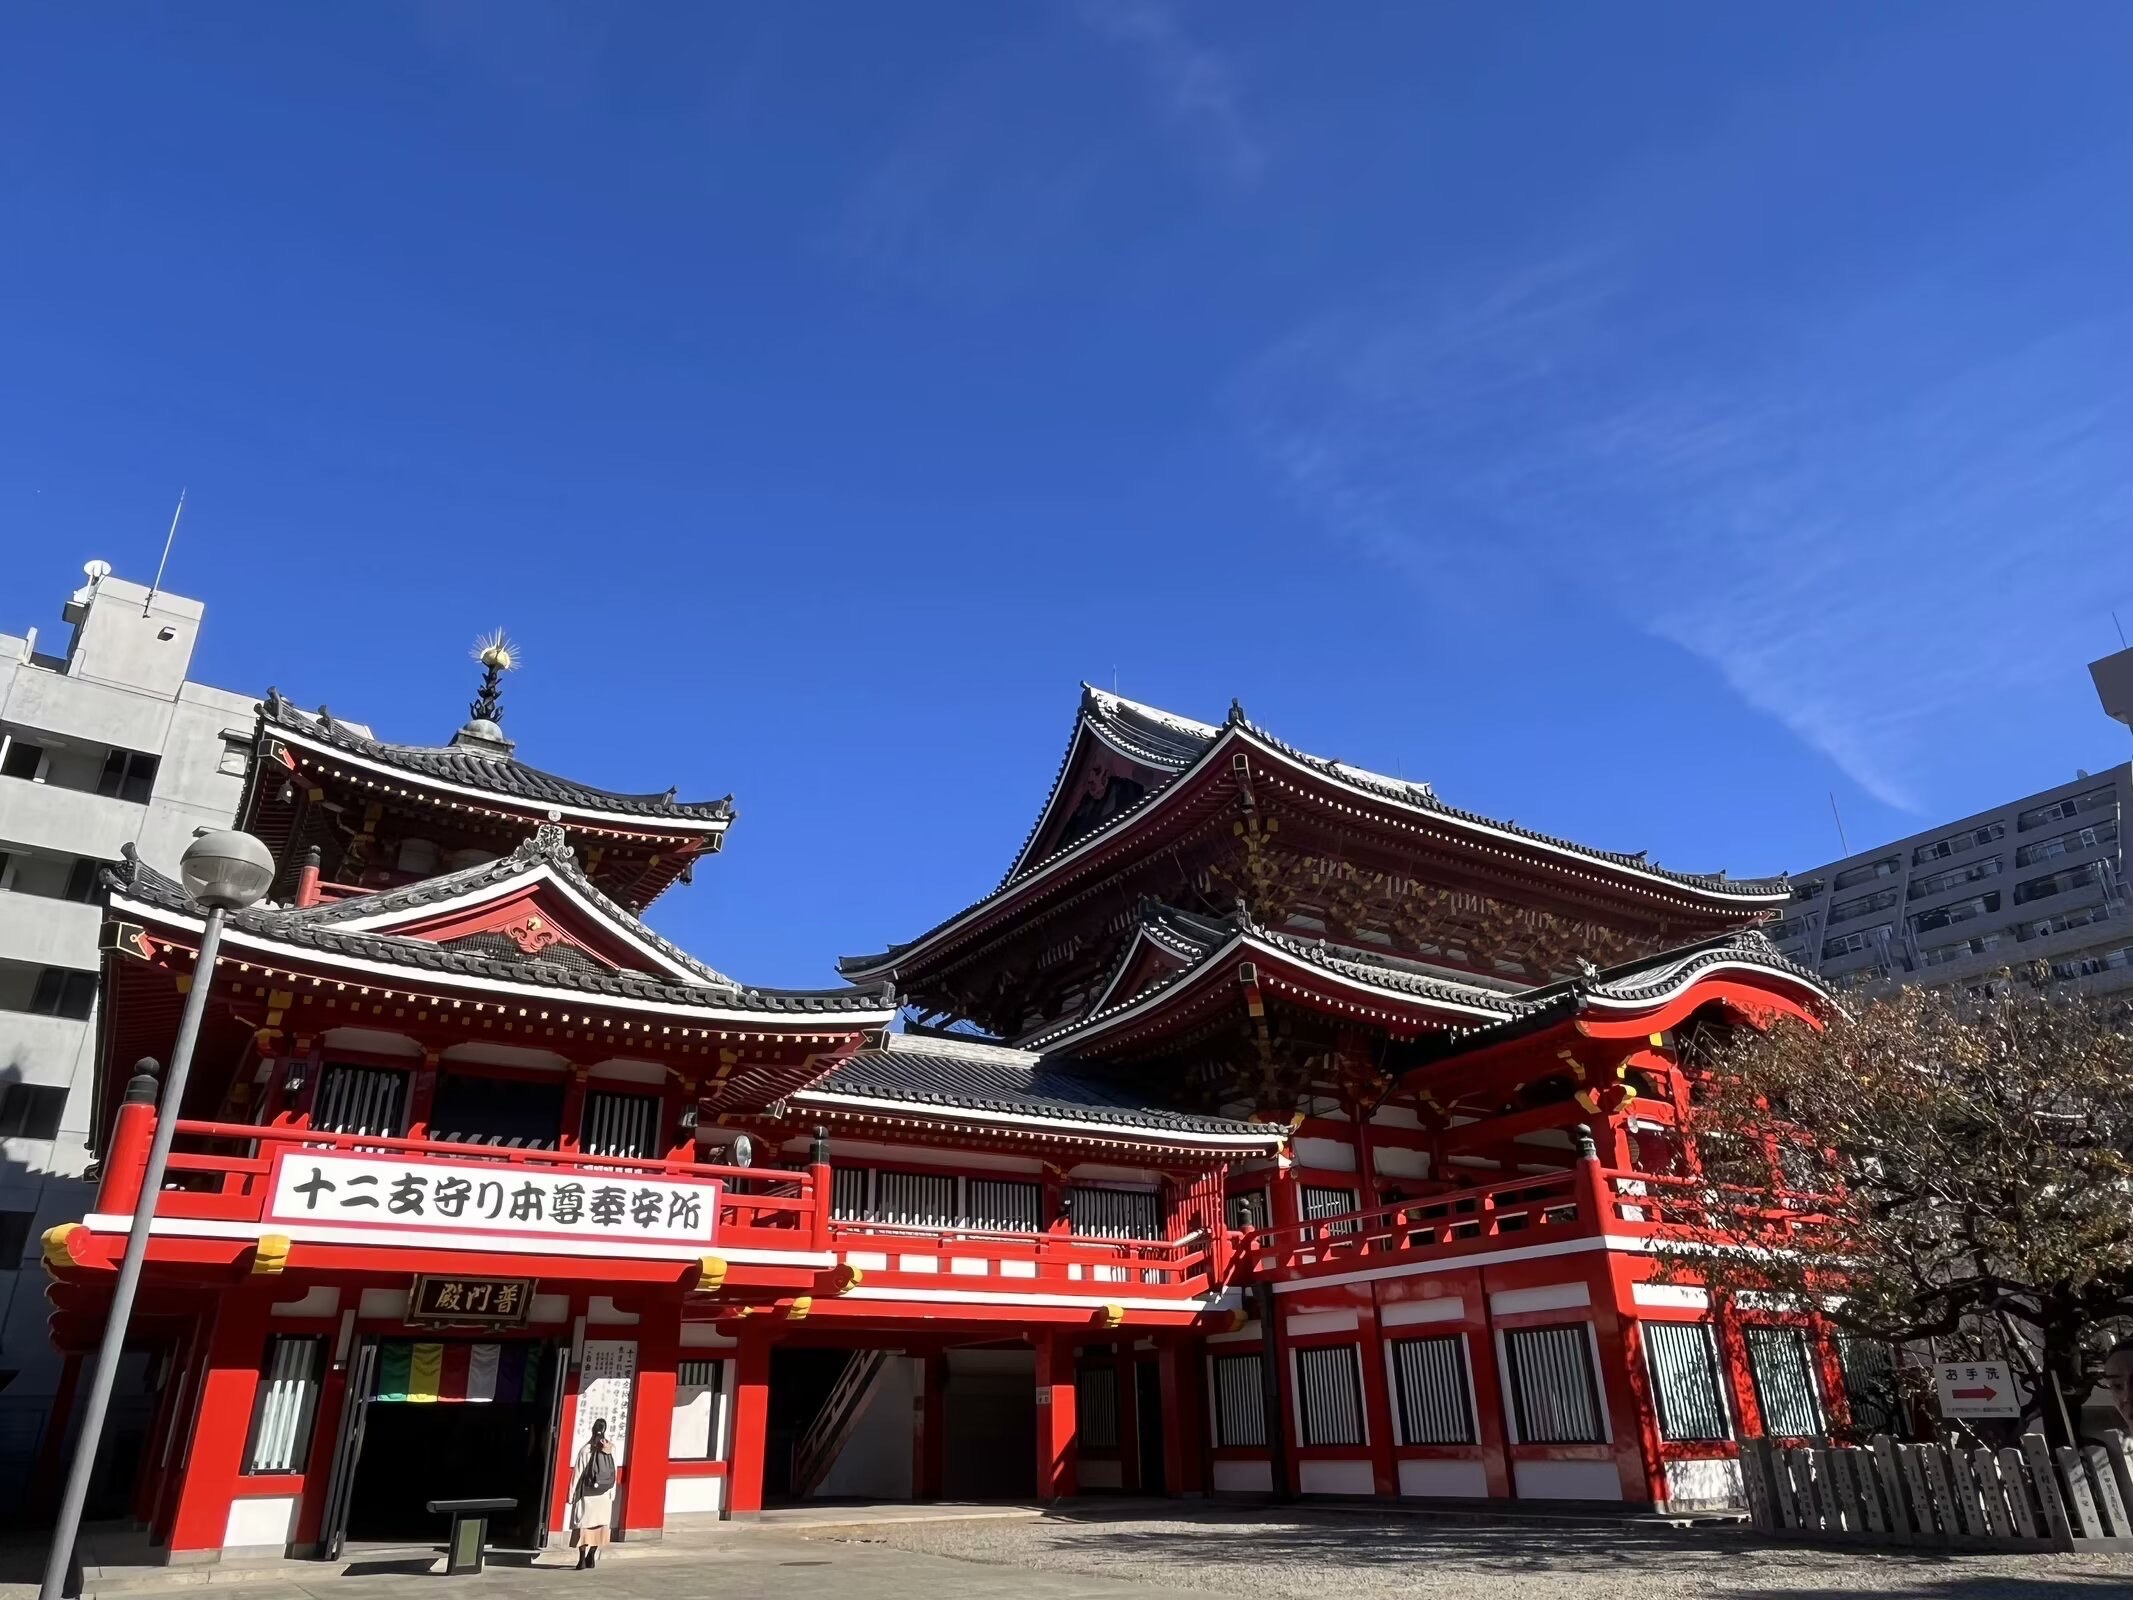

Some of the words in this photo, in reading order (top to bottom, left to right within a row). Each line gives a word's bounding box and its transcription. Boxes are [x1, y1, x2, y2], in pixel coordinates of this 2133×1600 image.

[293, 1167, 702, 1229] 十二支守り本尊奉安所
[435, 1283, 518, 1313] 普門殿
[1945, 1367, 2000, 1381] お手洗
